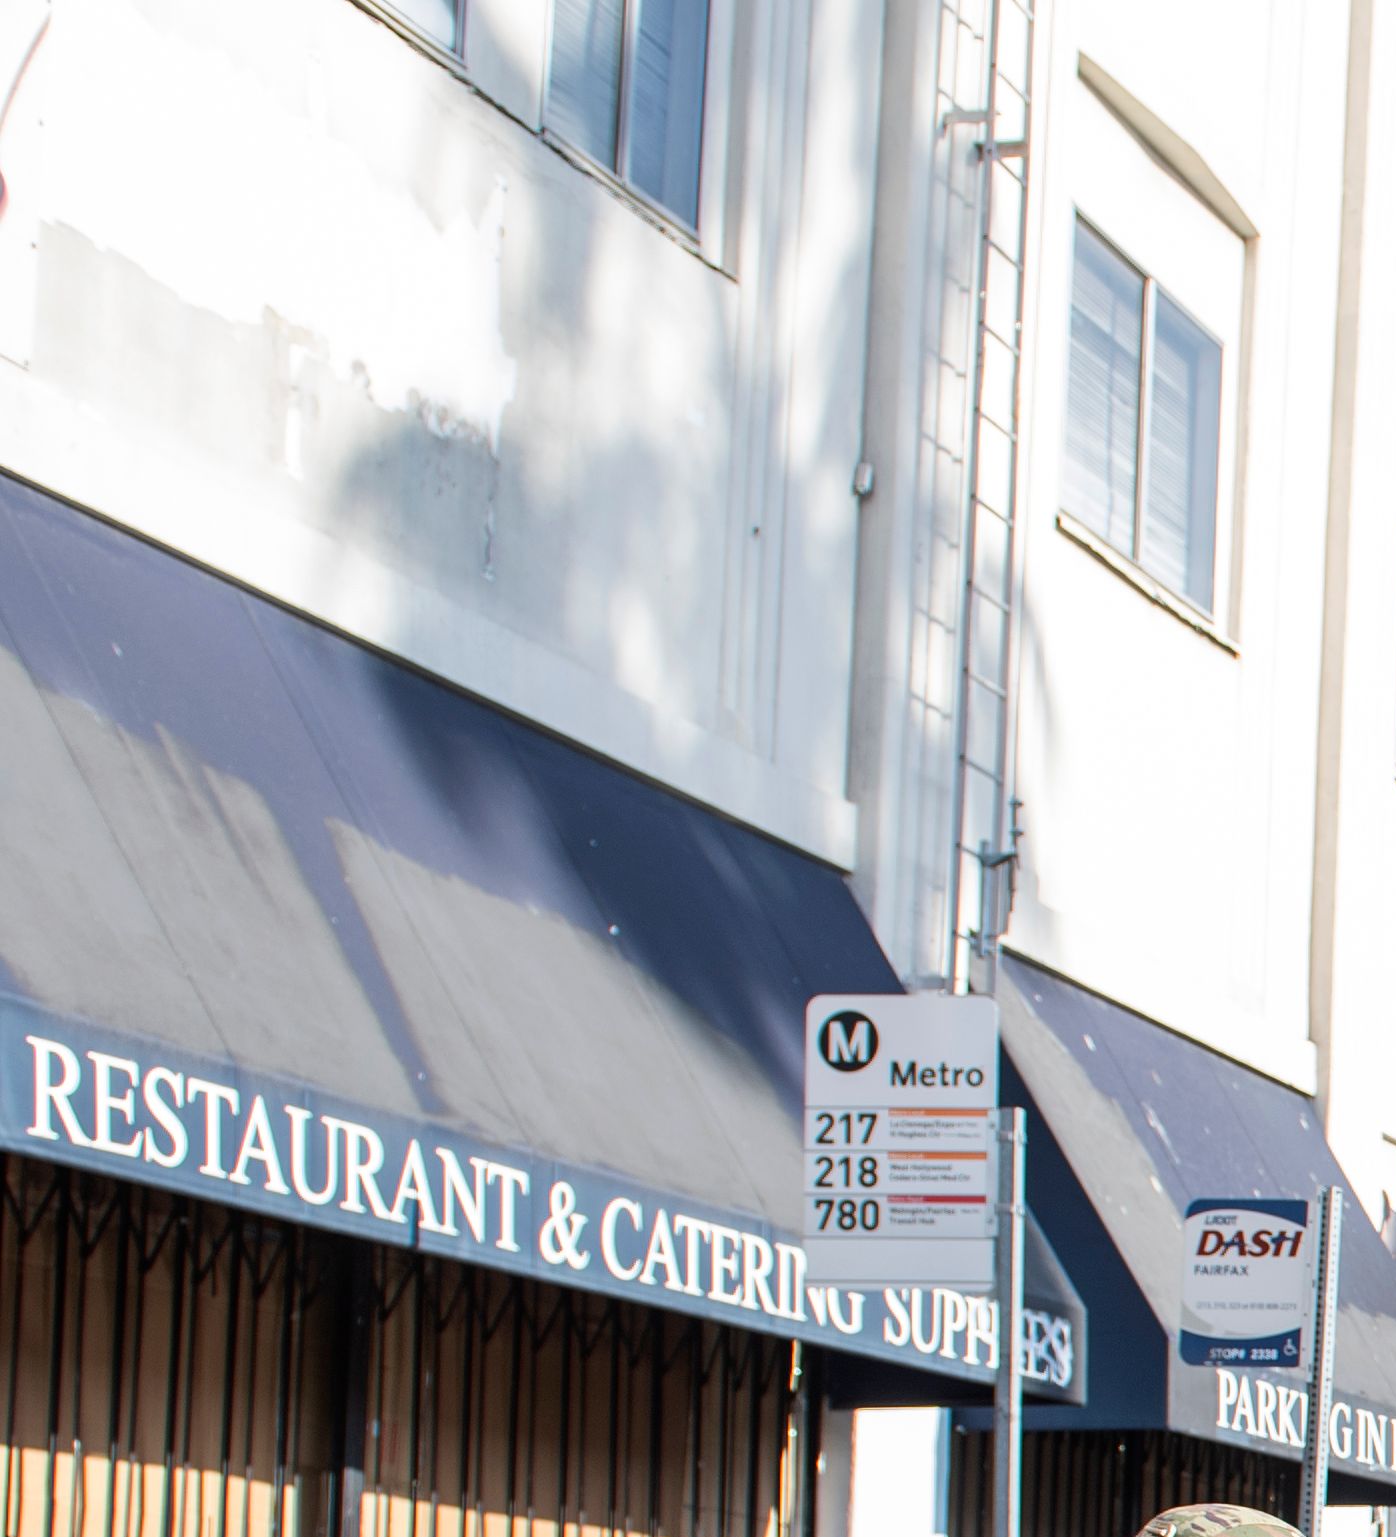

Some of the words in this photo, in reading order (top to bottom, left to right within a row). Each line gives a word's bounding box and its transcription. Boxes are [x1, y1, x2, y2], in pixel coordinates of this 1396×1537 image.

[828, 1020, 870, 1063] M
[890, 1061, 984, 1088] Metro
[815, 1112, 878, 1144] 217
[26, 1035, 530, 1252] RESTAURANT
[538, 1180, 590, 1270] &
[815, 1156, 878, 1187] 218
[815, 1199, 879, 1231] 780
[1196, 1230, 1304, 1258] DASH
[1194, 1264, 1249, 1276] FAIRFAX
[1356, 1408, 1390, 1470] IN
